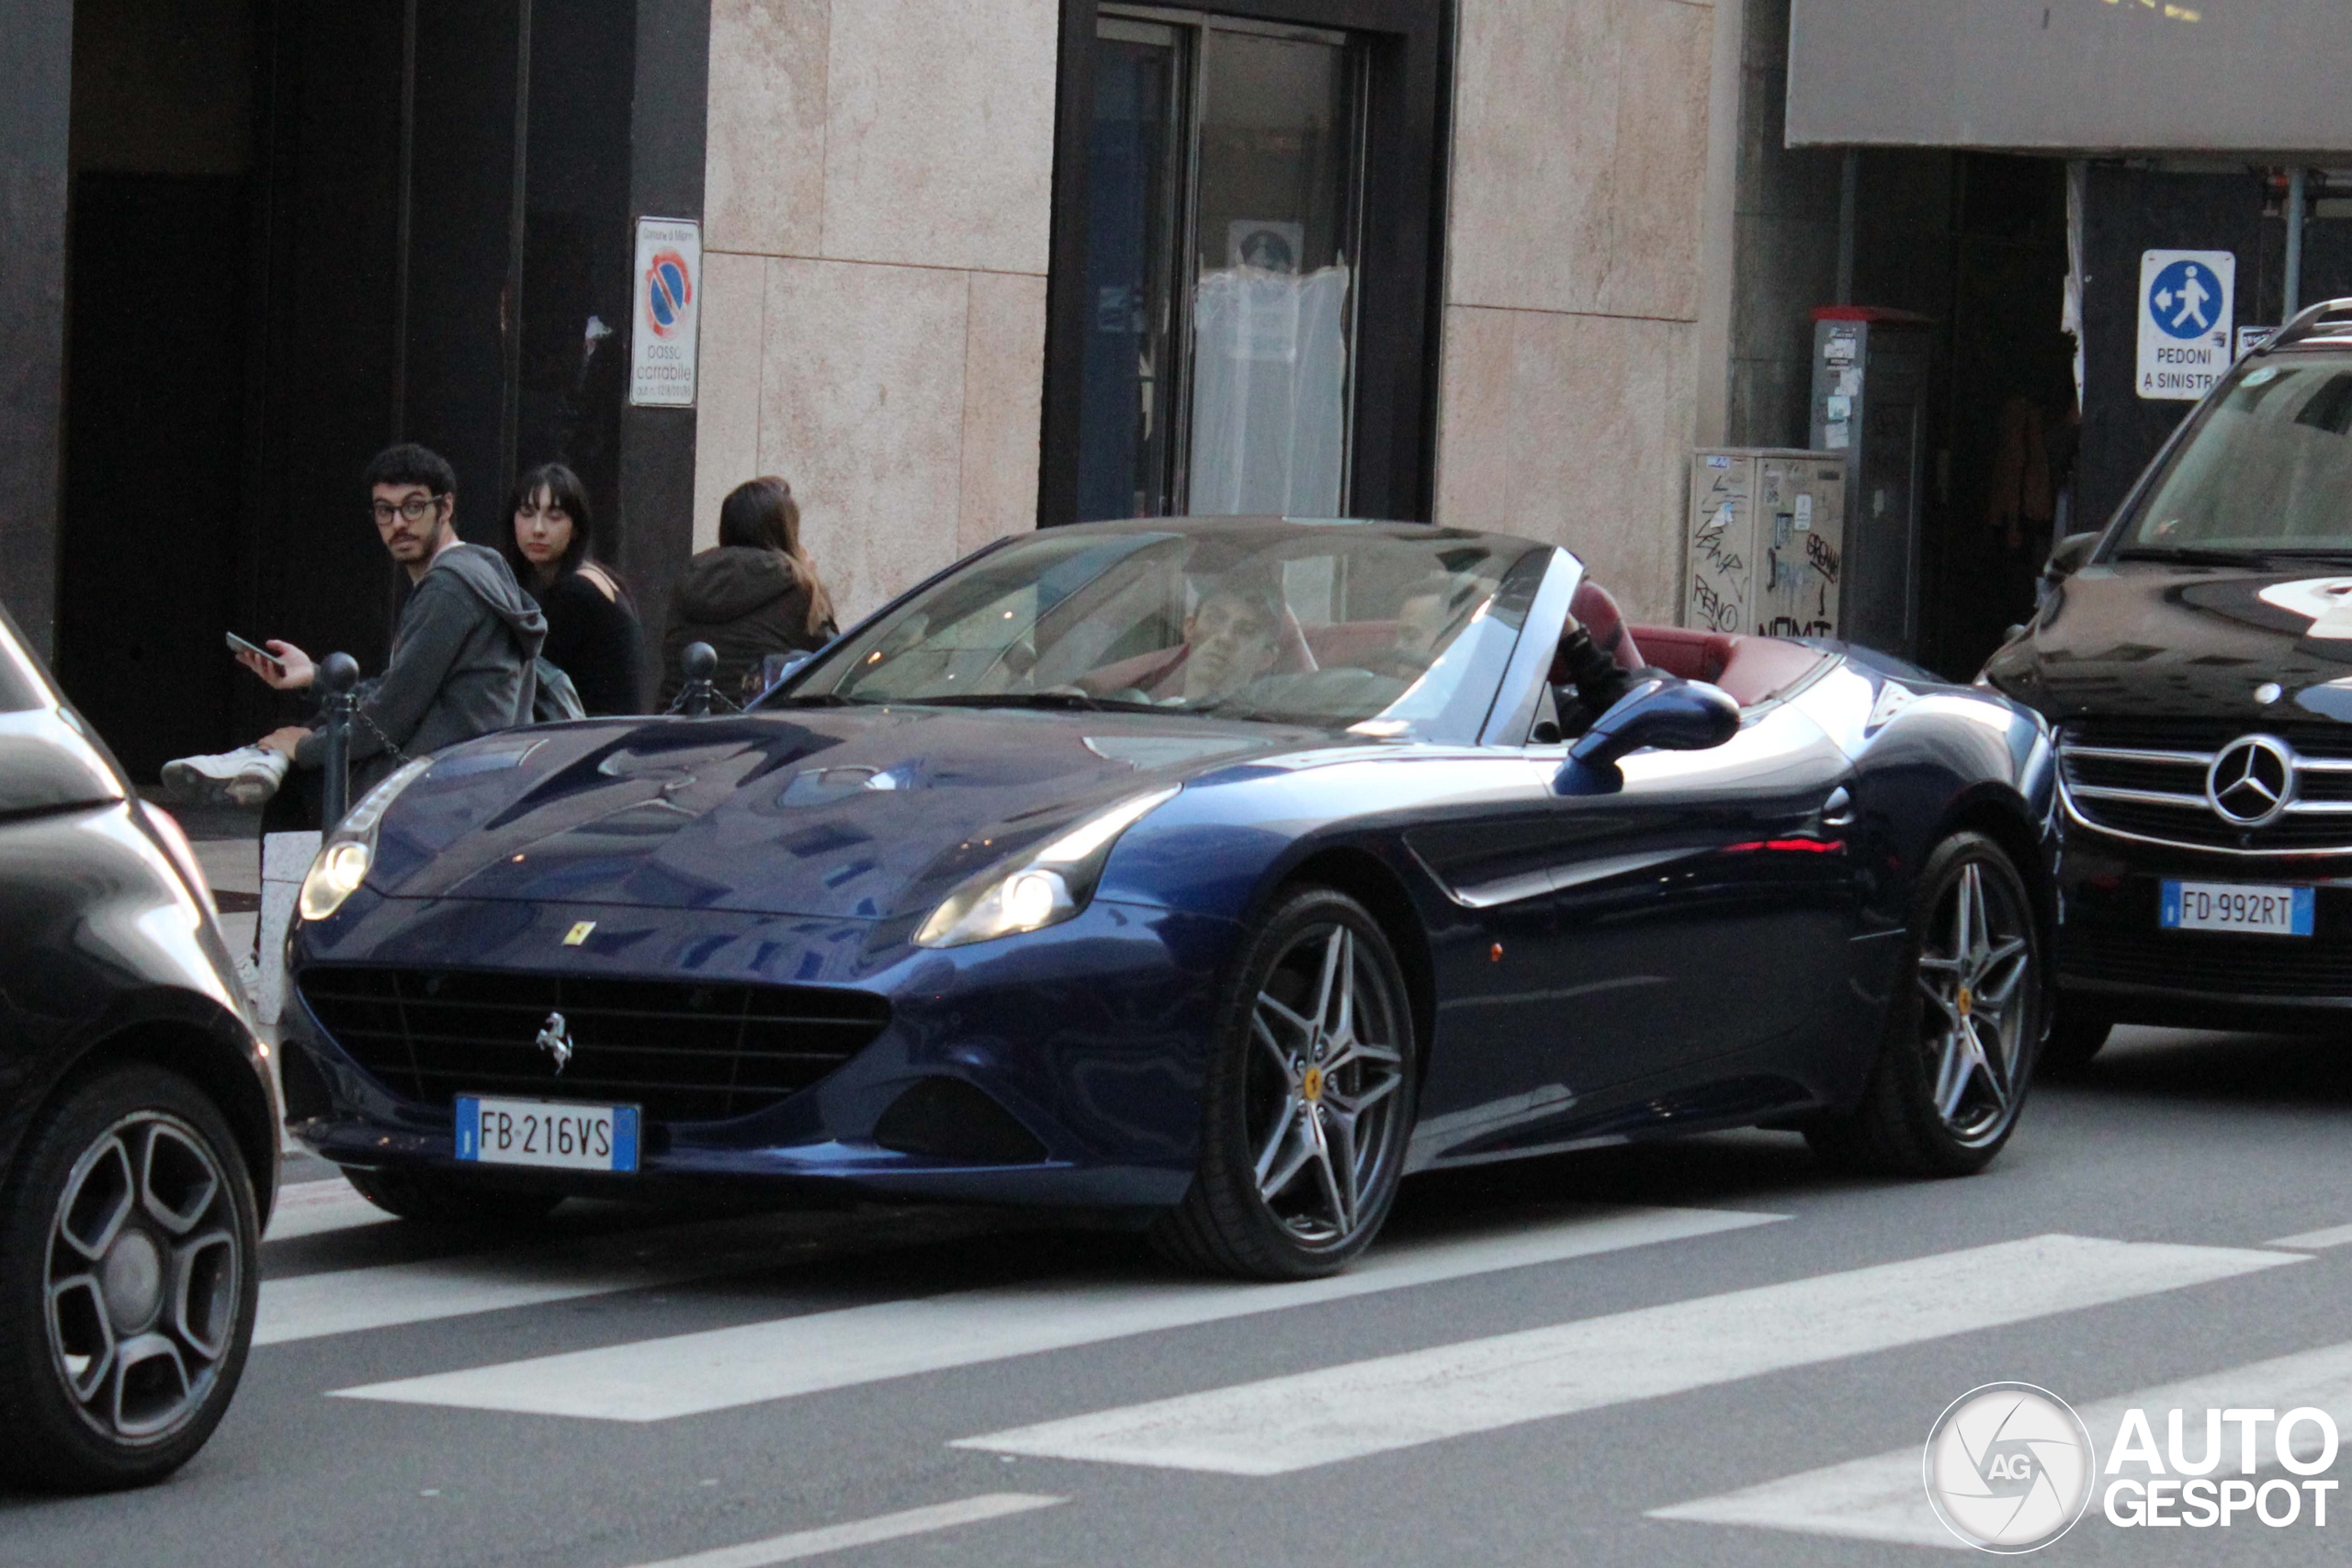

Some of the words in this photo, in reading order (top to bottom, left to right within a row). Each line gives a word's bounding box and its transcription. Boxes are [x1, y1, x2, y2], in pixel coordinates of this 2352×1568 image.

[2157, 347, 2211, 365] PEDONI
[637, 362, 692, 381] carrabile
[2143, 372, 2153, 388] A
